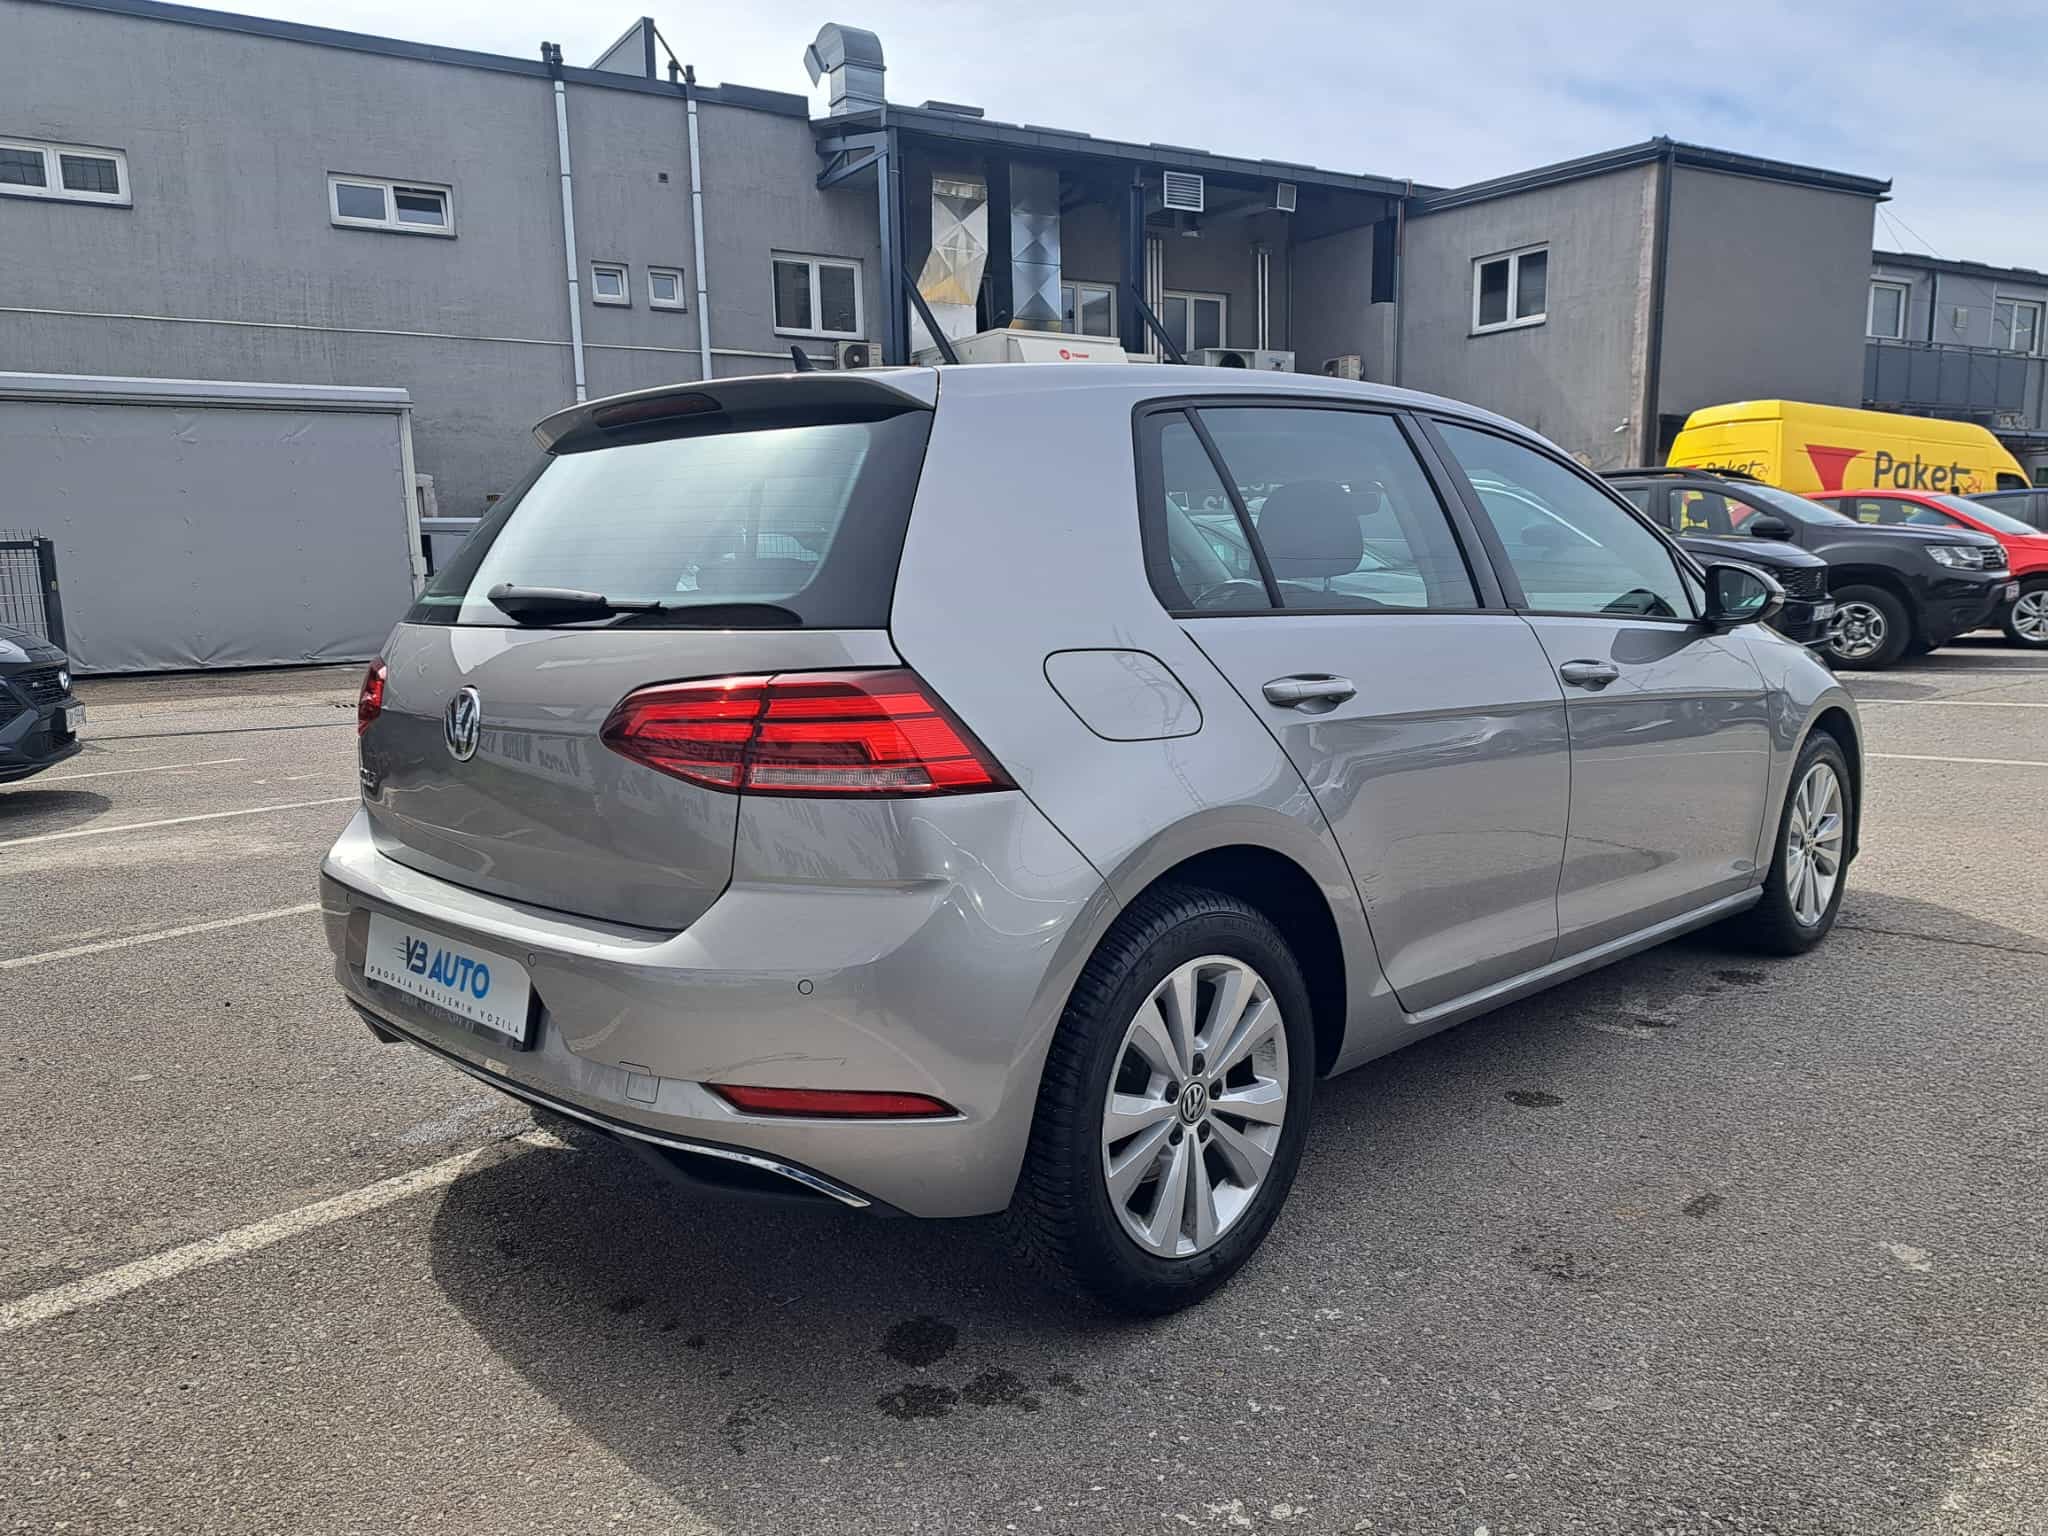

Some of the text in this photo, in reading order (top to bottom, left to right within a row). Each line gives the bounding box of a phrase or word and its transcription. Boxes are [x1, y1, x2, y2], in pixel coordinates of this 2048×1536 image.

[1874, 450, 1971, 492] Paket
[369, 965, 412, 988] PRODAJA
[480, 1009, 519, 1033] VOZILA
[428, 948, 490, 999] AUTO
